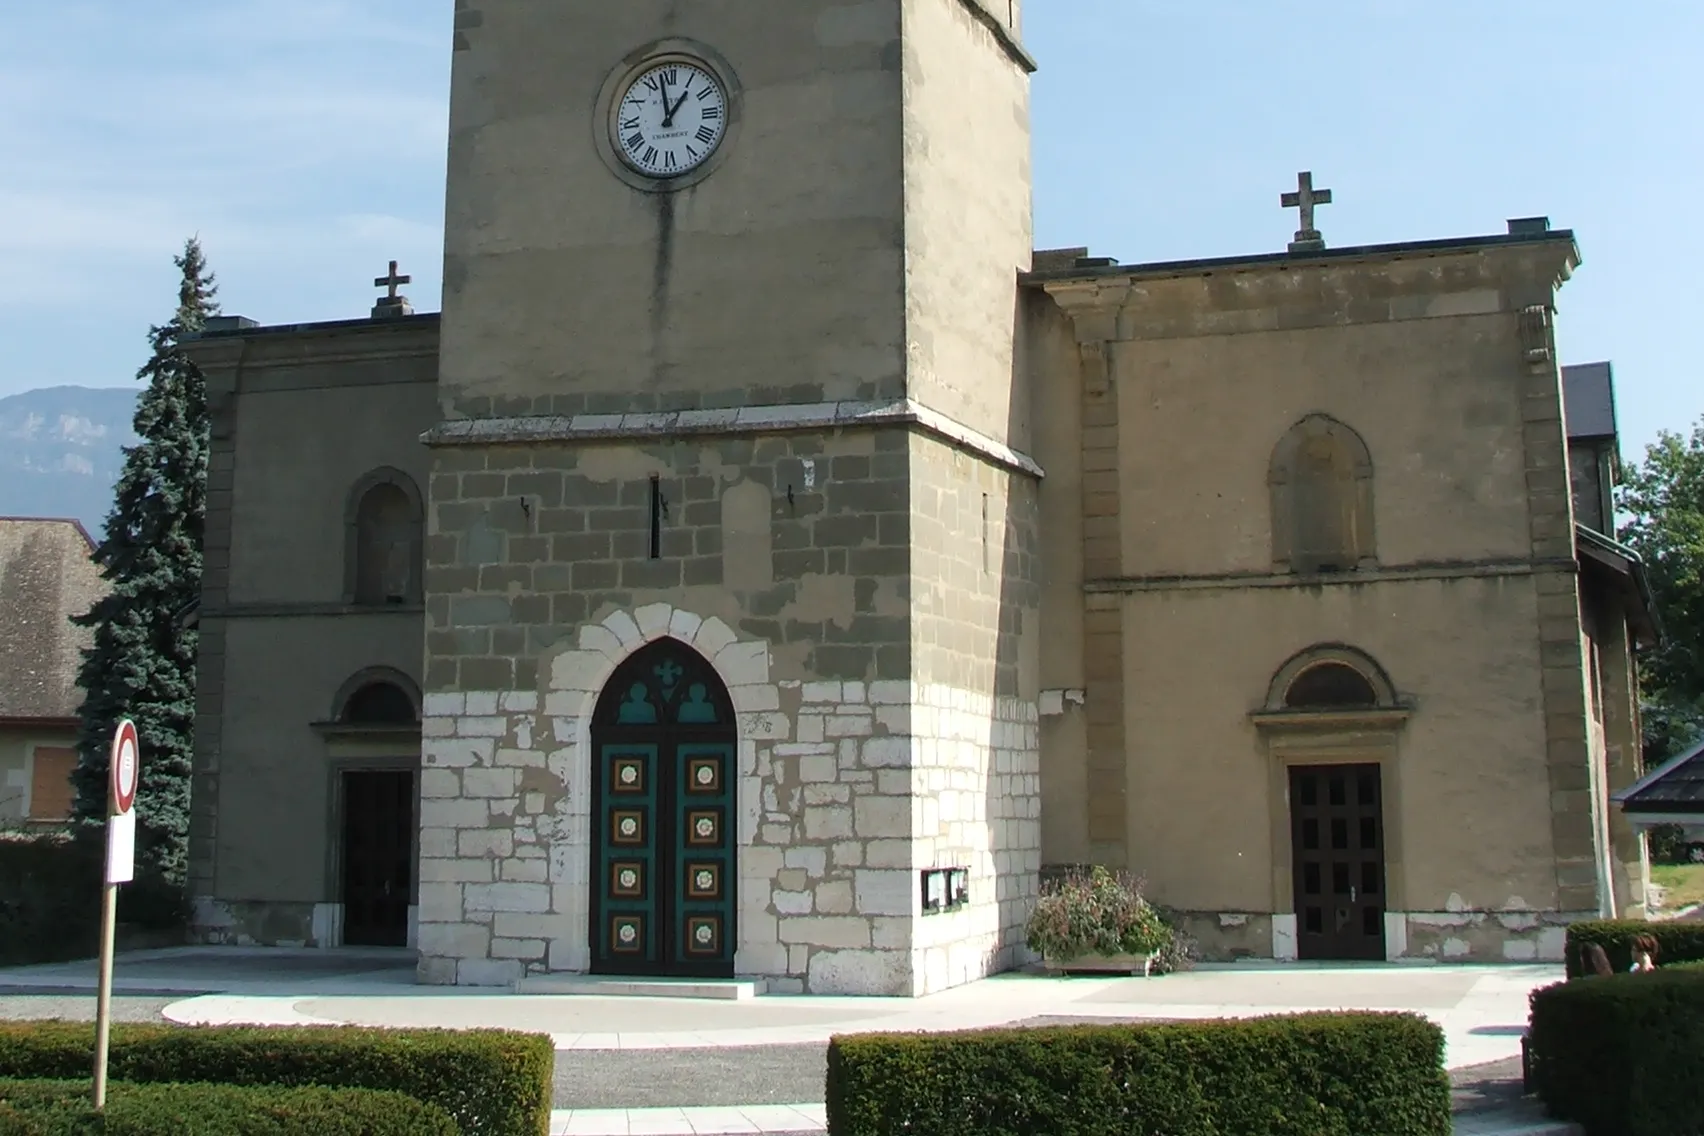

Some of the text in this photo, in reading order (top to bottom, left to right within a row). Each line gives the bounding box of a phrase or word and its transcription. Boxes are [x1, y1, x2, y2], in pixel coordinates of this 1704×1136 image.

[685, 73, 695, 88] I
[696, 86, 712, 100] II
[702, 107, 718, 119] III
[695, 126, 715, 144] IIII
[665, 151, 676, 167] VI
[686, 144, 698, 160] V
